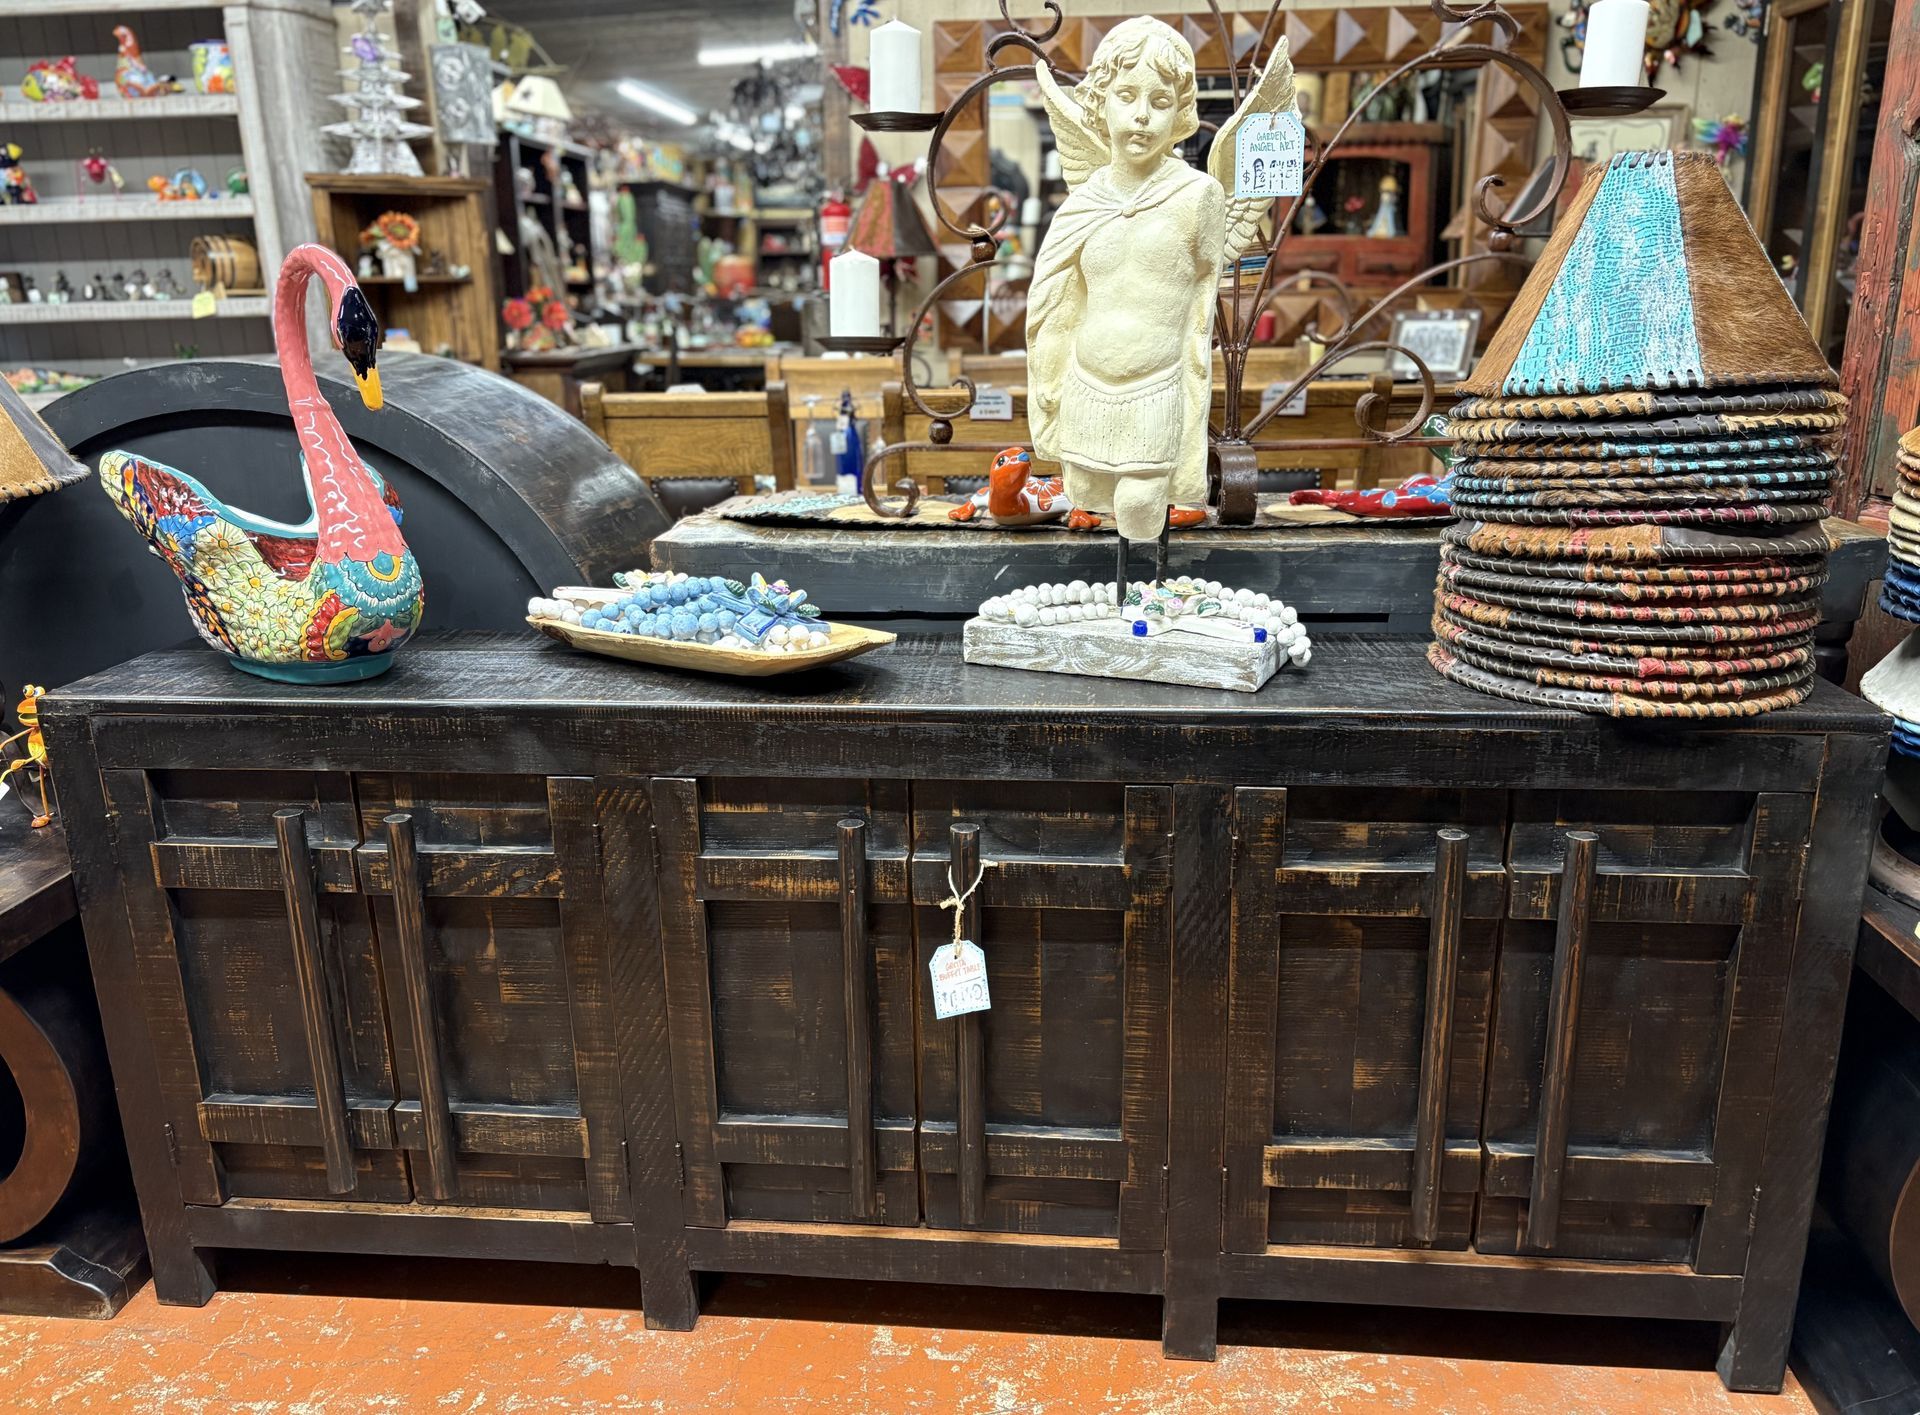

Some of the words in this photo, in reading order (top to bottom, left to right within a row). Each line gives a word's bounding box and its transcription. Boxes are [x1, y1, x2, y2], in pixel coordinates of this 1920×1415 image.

[1256, 131, 1287, 141] GARDEN
[1250, 142, 1275, 152] ANGEL
[1279, 140, 1295, 151] ART
